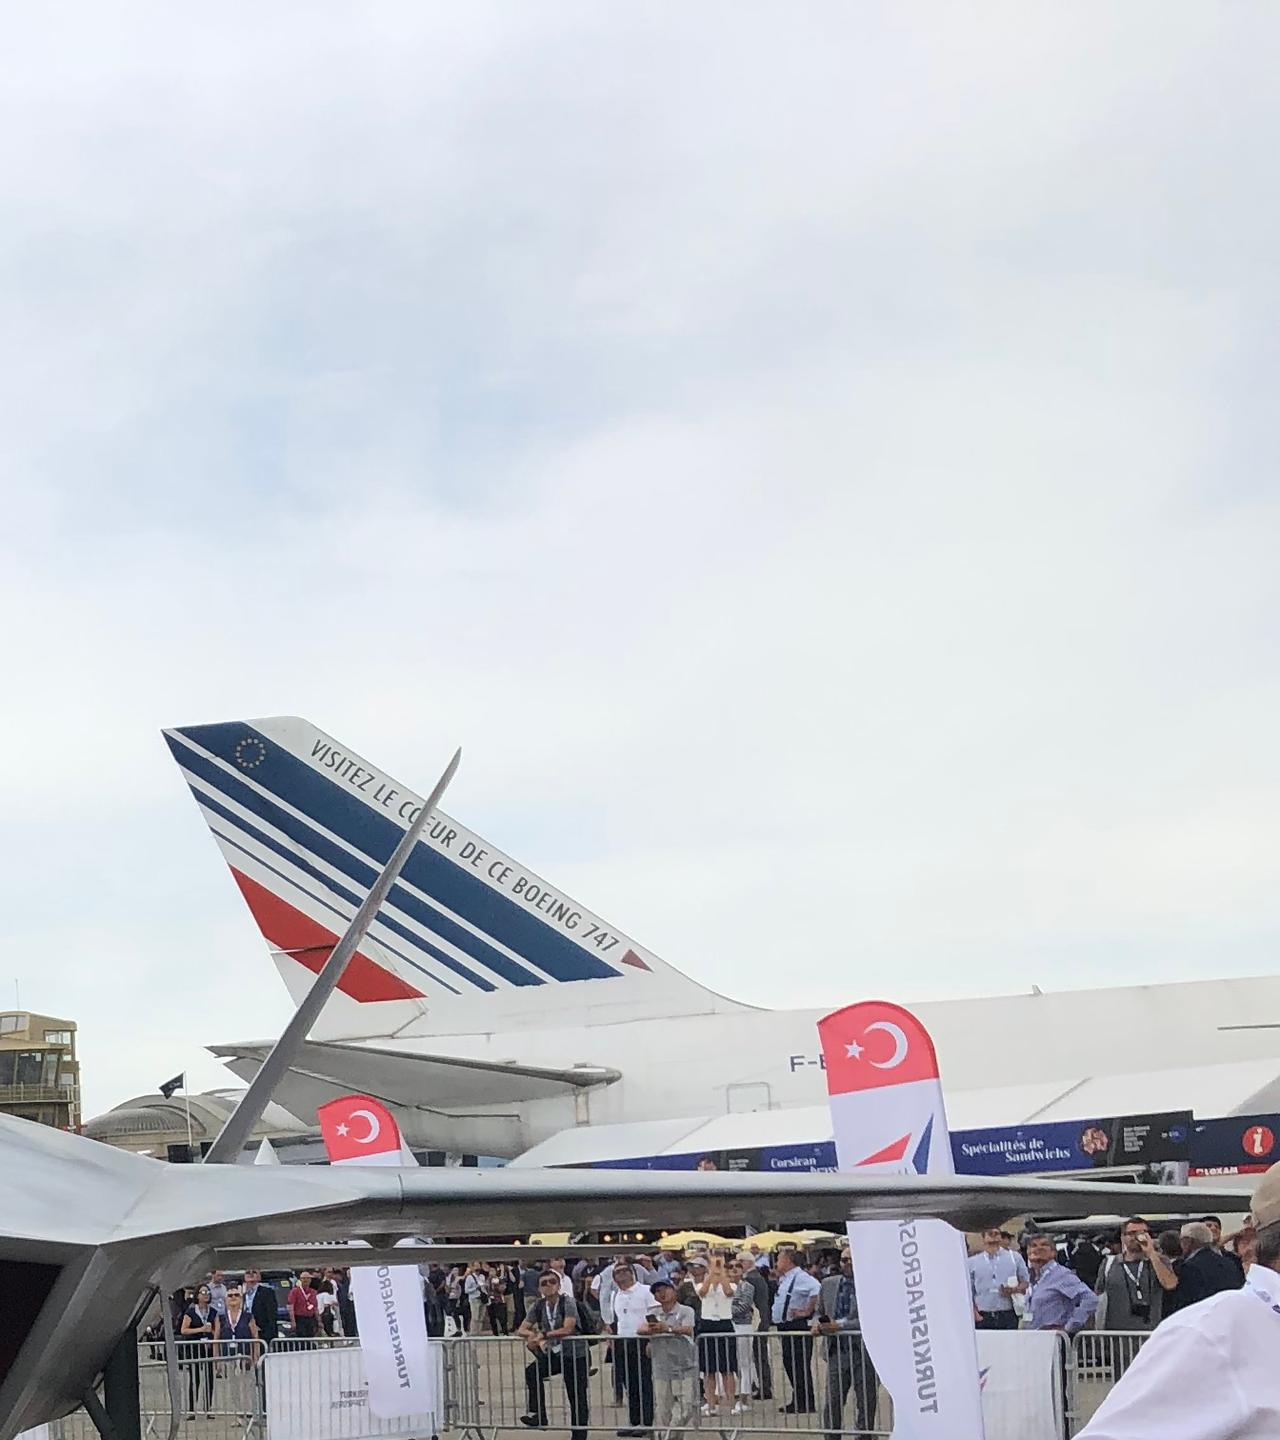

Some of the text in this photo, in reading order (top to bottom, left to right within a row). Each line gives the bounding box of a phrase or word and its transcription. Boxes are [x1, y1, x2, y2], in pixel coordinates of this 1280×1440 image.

[310, 739, 376, 792] VISITEZ
[372, 783, 399, 808] LE
[458, 842, 488, 868] DE
[487, 861, 514, 885] CE
[511, 876, 582, 930] BOEING
[581, 922, 621, 952] 747
[1028, 1138, 1044, 1150] de
[1204, 1166, 1239, 1176] LOXAM
